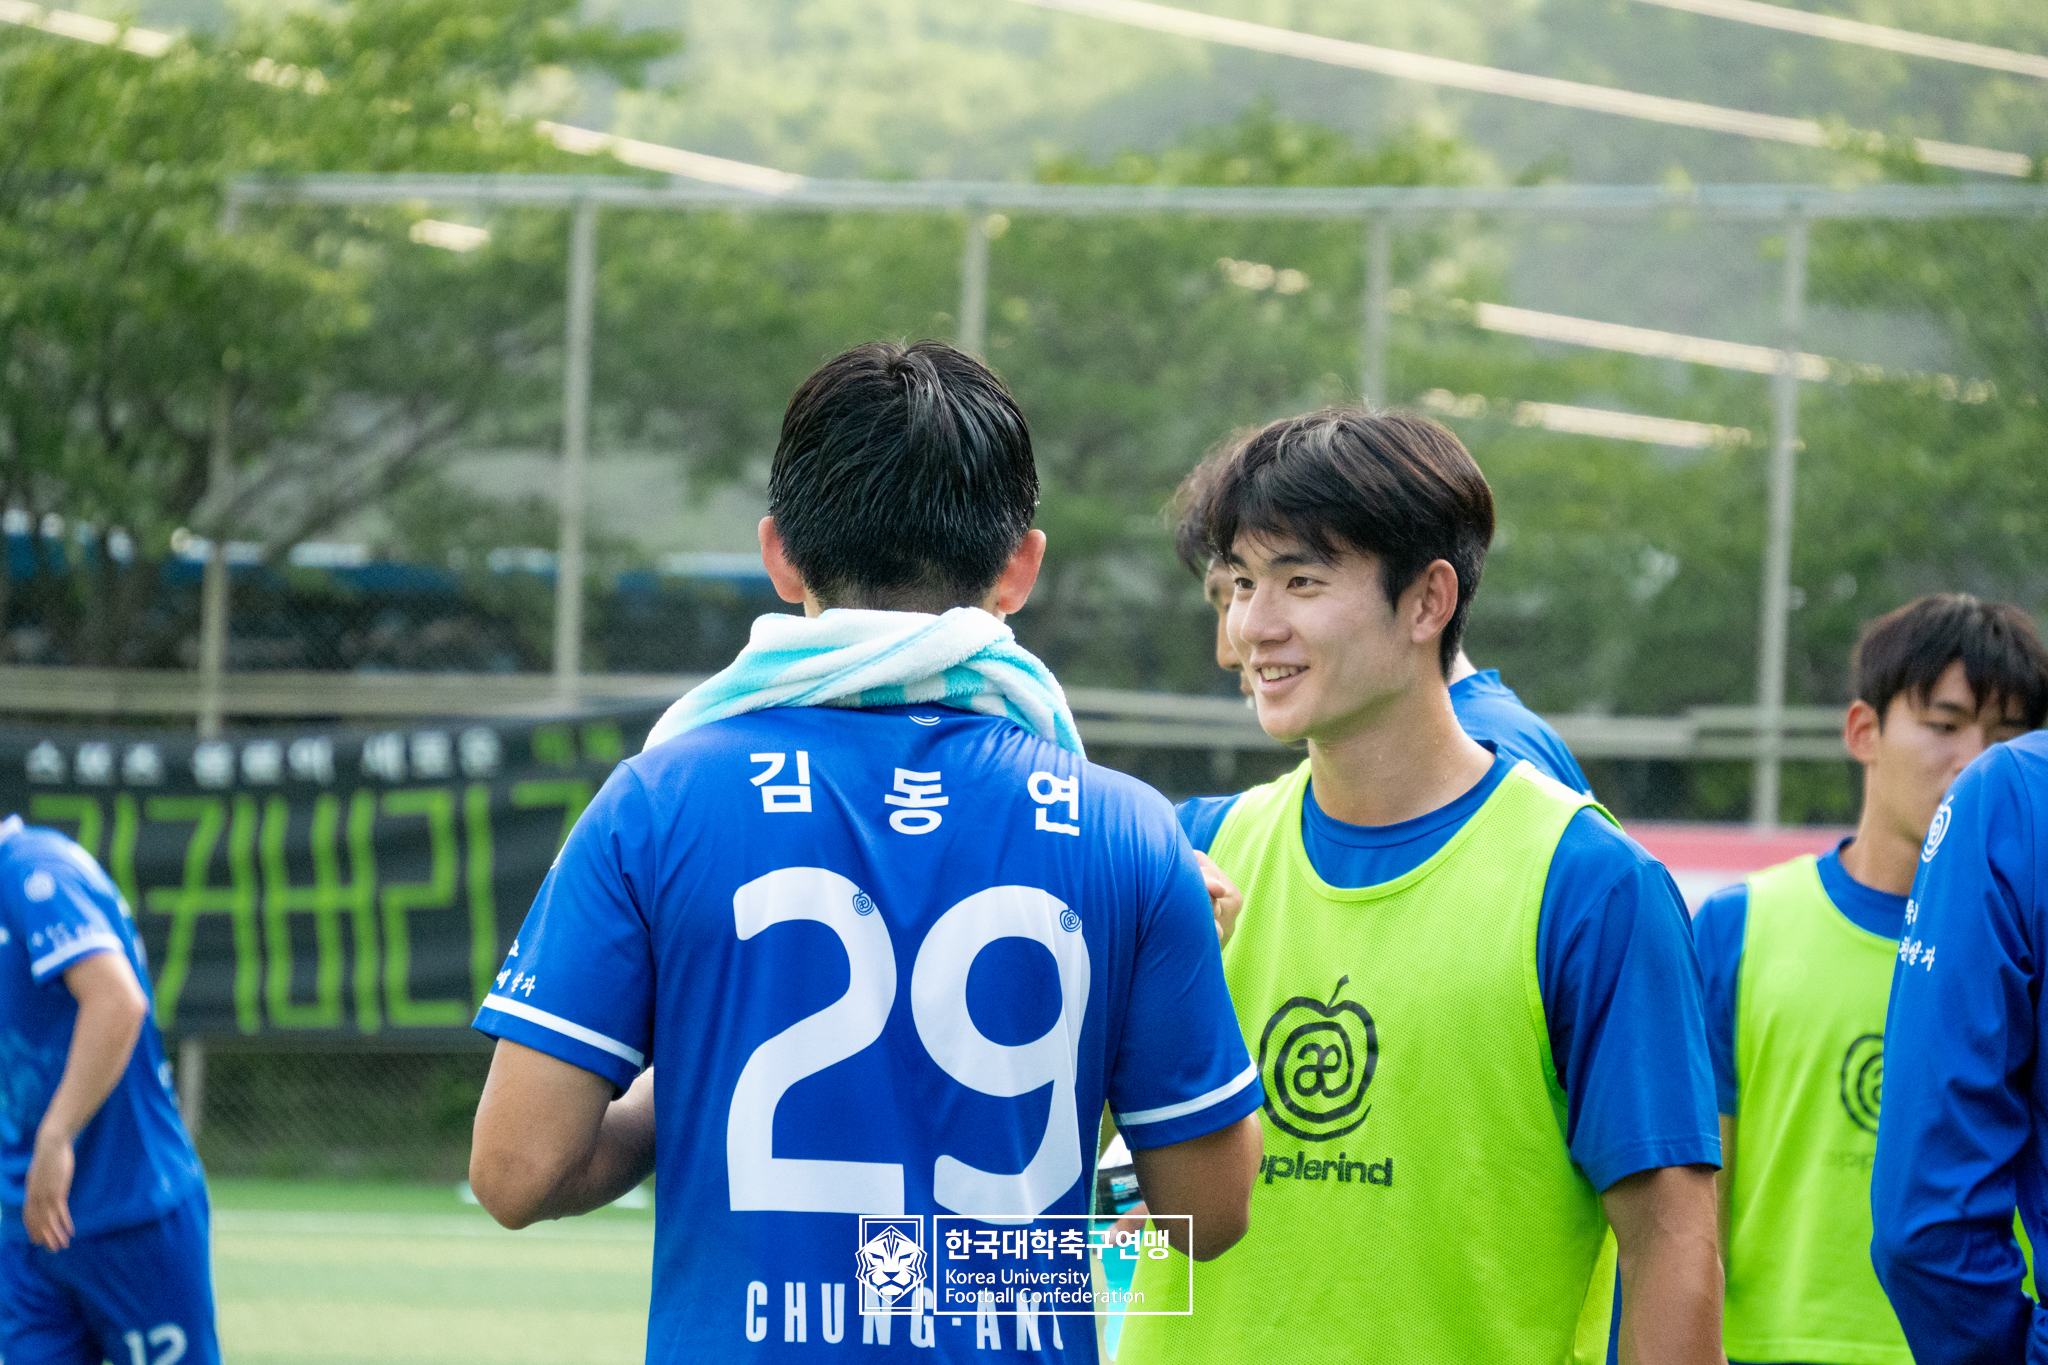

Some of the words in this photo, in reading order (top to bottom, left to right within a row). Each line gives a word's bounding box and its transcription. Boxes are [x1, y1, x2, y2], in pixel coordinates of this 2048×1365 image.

[748, 749, 1082, 837] 김동연
[726, 866, 1092, 1226] 29
[1260, 1150, 1393, 1187] plerind
[124, 1322, 188, 1365] 12
[745, 1279, 1065, 1352] CHUNG-AN
